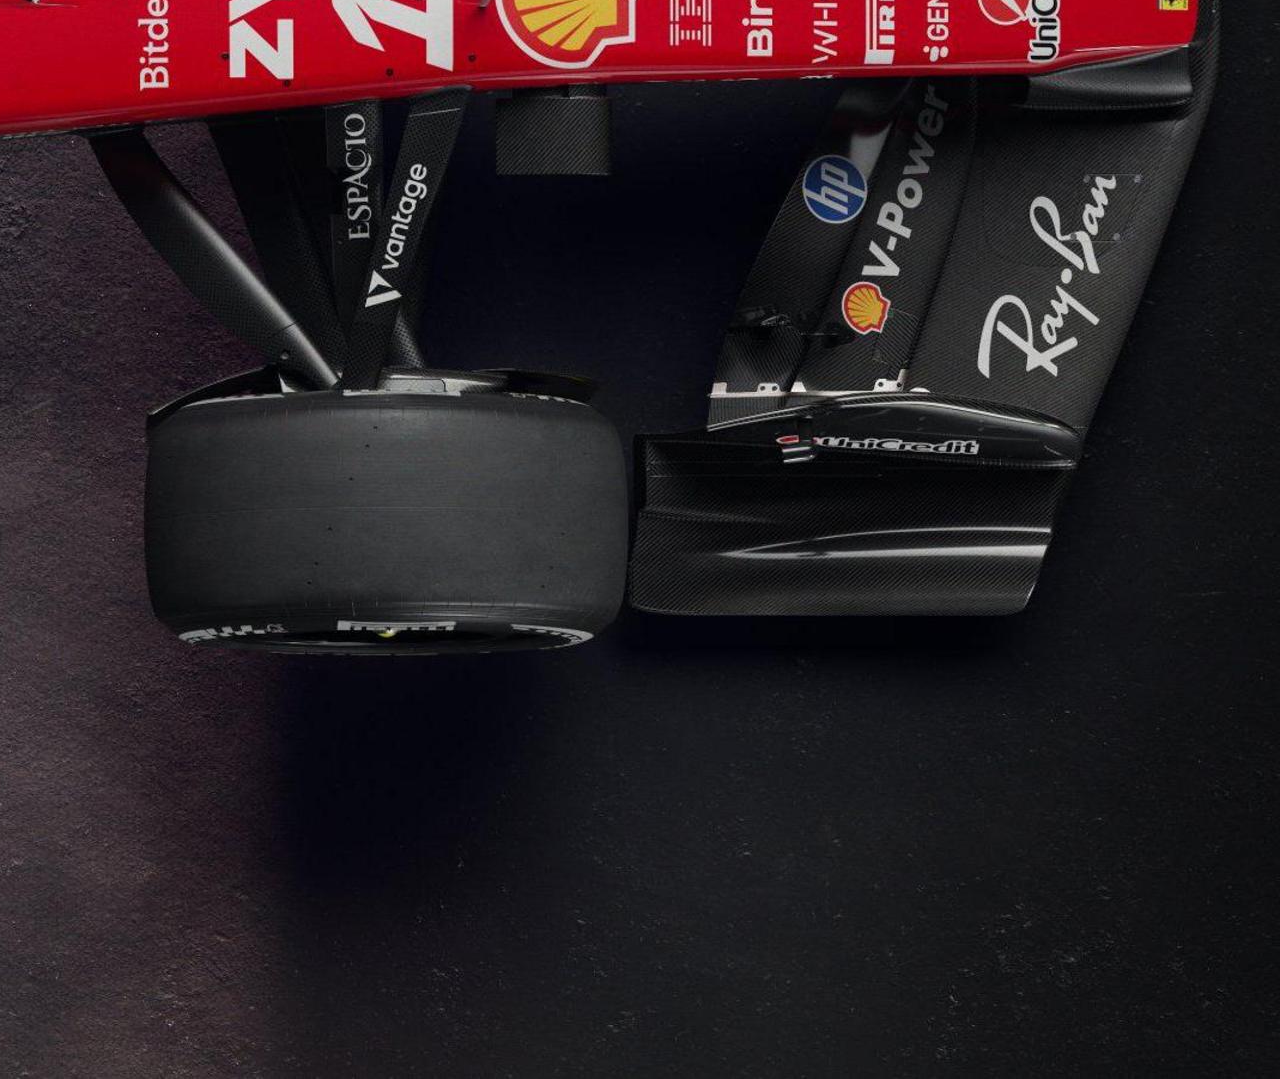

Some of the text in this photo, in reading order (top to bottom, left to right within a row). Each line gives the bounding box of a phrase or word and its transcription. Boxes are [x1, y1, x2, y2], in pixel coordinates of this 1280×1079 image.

[343, 113, 372, 240] ESPACIO
[381, 164, 428, 272] vantage
[803, 163, 868, 215] hp
[861, 86, 949, 278] V-Power
[814, 435, 981, 456] UniCredit
